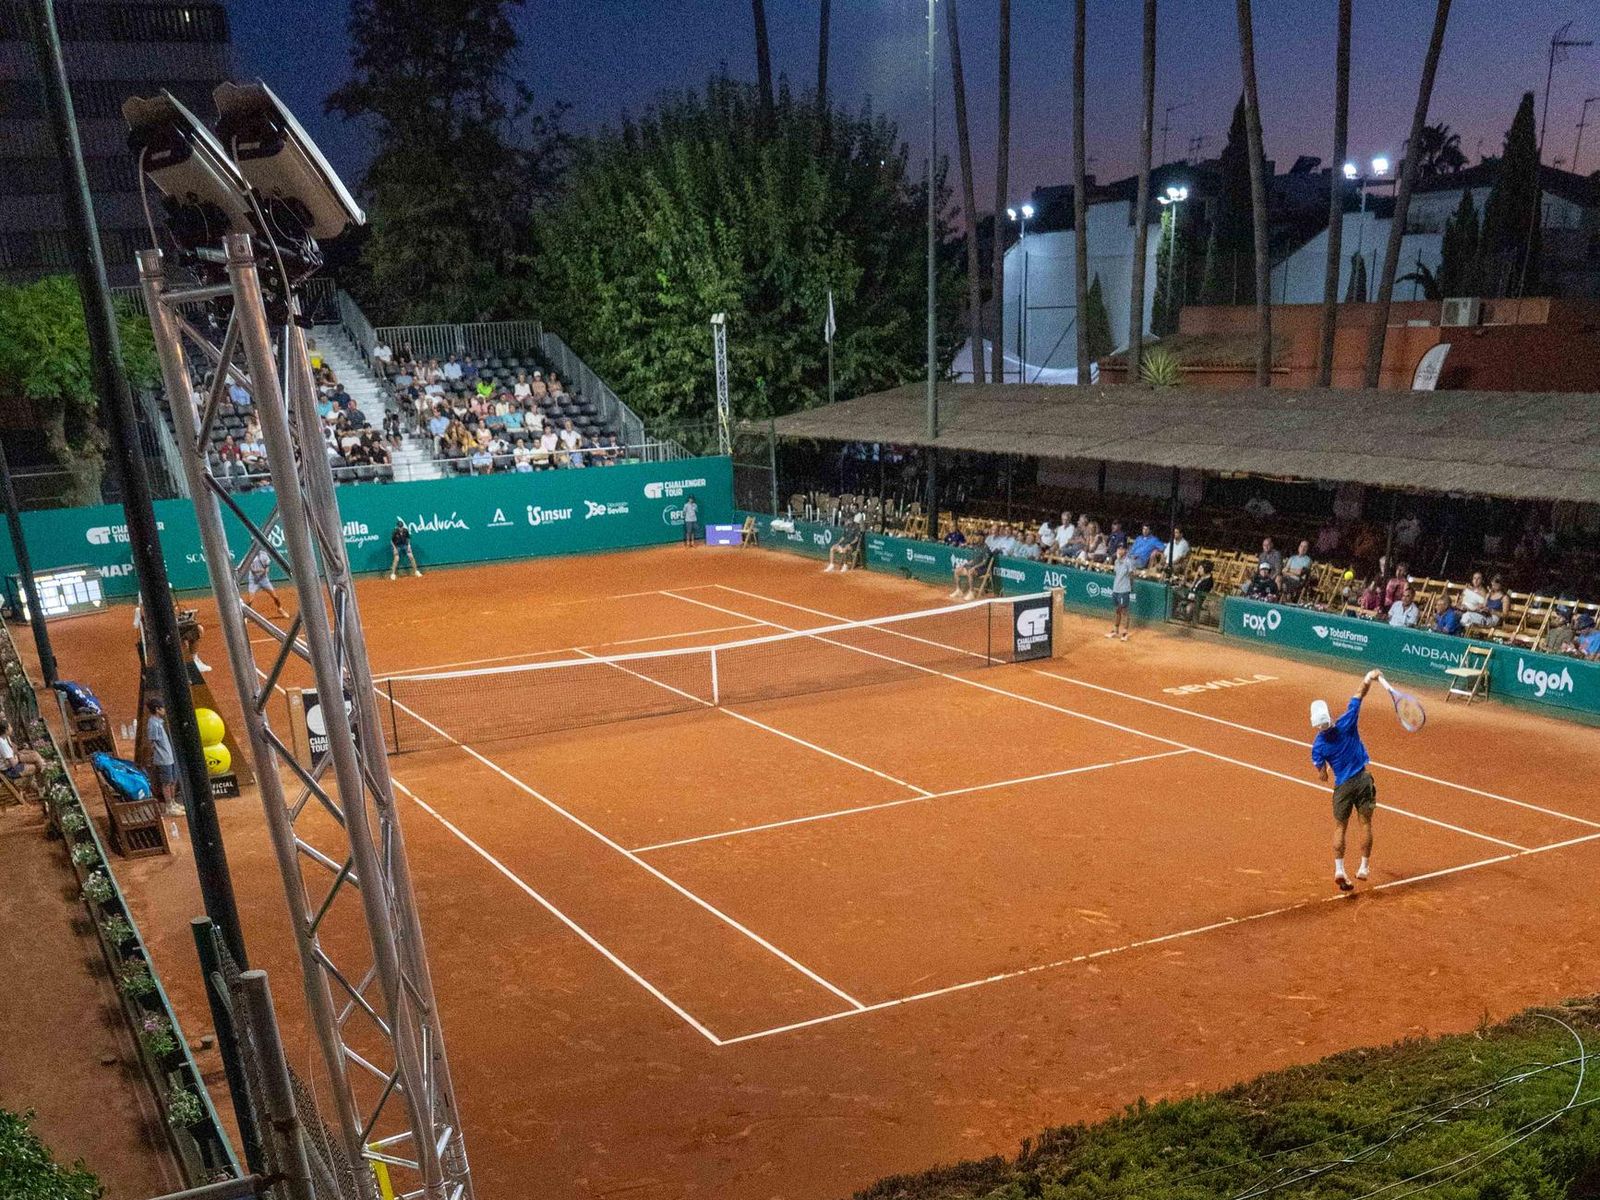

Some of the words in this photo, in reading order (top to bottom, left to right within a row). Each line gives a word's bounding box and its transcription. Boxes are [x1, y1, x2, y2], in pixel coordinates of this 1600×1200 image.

[664, 478, 706, 489] CHALLENGER
[664, 487, 683, 497] TOUR
[112, 533, 130, 543] TOU
[1043, 570, 1068, 588] ABC
[1162, 674, 1279, 696] SEVILLA
